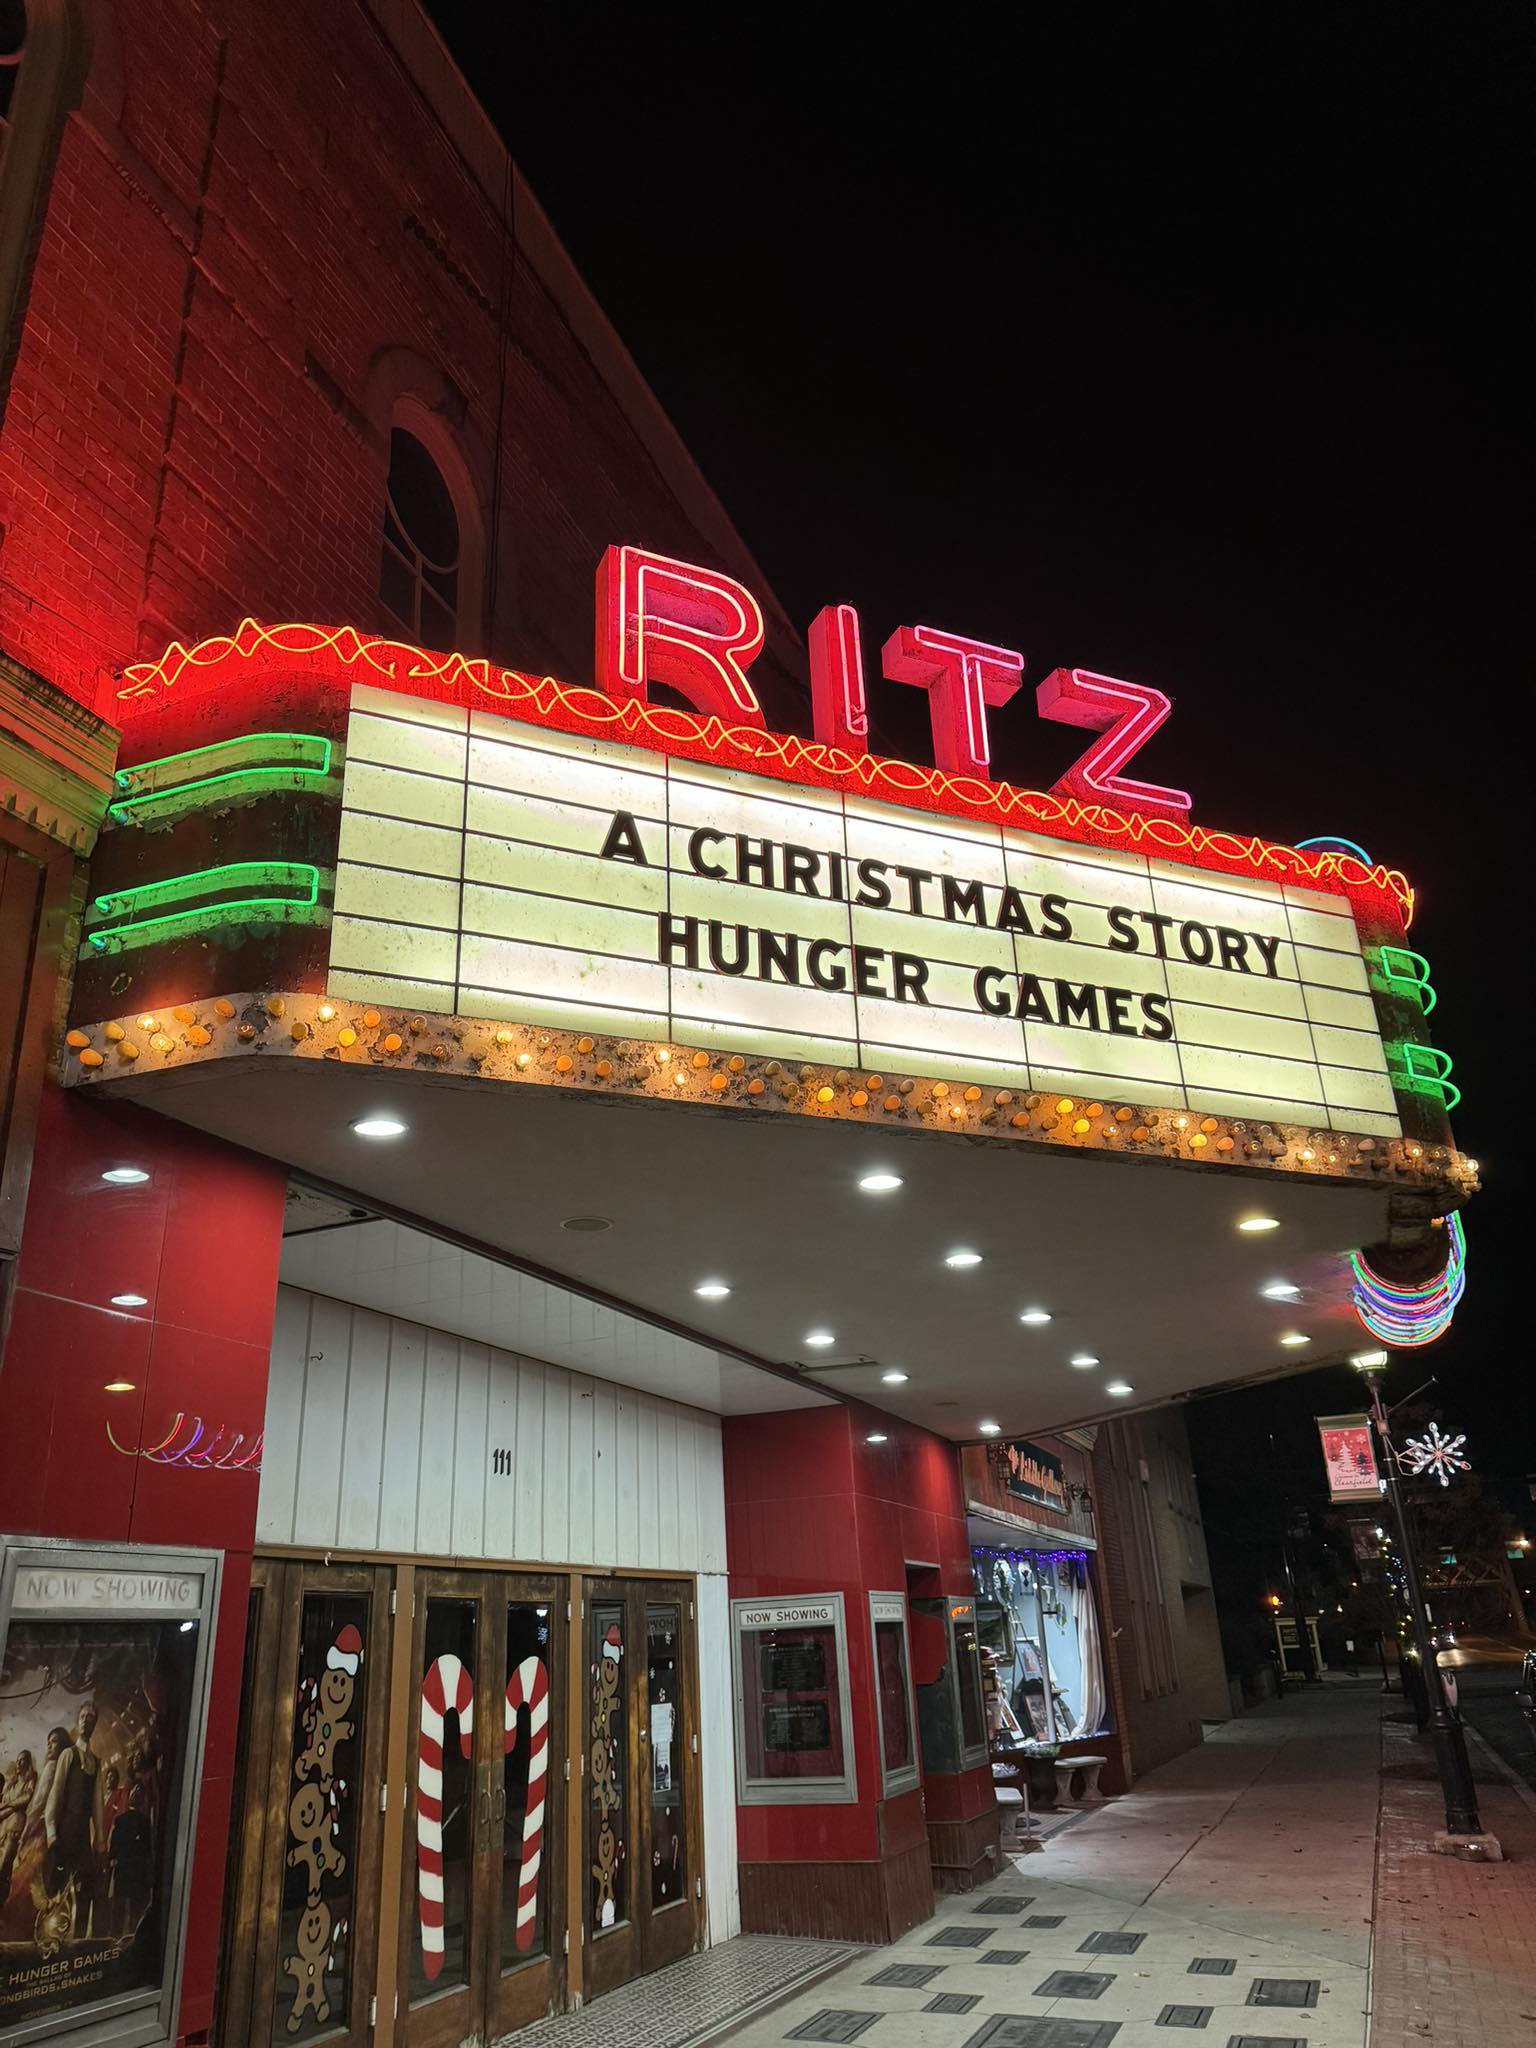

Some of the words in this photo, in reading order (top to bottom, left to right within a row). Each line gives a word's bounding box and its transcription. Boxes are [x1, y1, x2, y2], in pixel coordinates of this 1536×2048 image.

[596, 544, 1194, 824] RITZ
[599, 810, 649, 866] A
[687, 827, 1074, 942] CHRISTMAS
[1107, 906, 1281, 979] STORY
[657, 912, 930, 1006] HUNGER
[972, 966, 1175, 1042] GAMES
[492, 1448, 511, 1475] 111
[27, 1576, 78, 1598] NOW
[92, 1576, 190, 1601] SHOWING
[746, 1613, 772, 1624] NOW
[776, 1608, 828, 1622] SHOWING
[9, 1960, 69, 1986] HUNGER
[74, 1947, 121, 1969] GAMES
[61, 1971, 102, 1989] SNAKES
